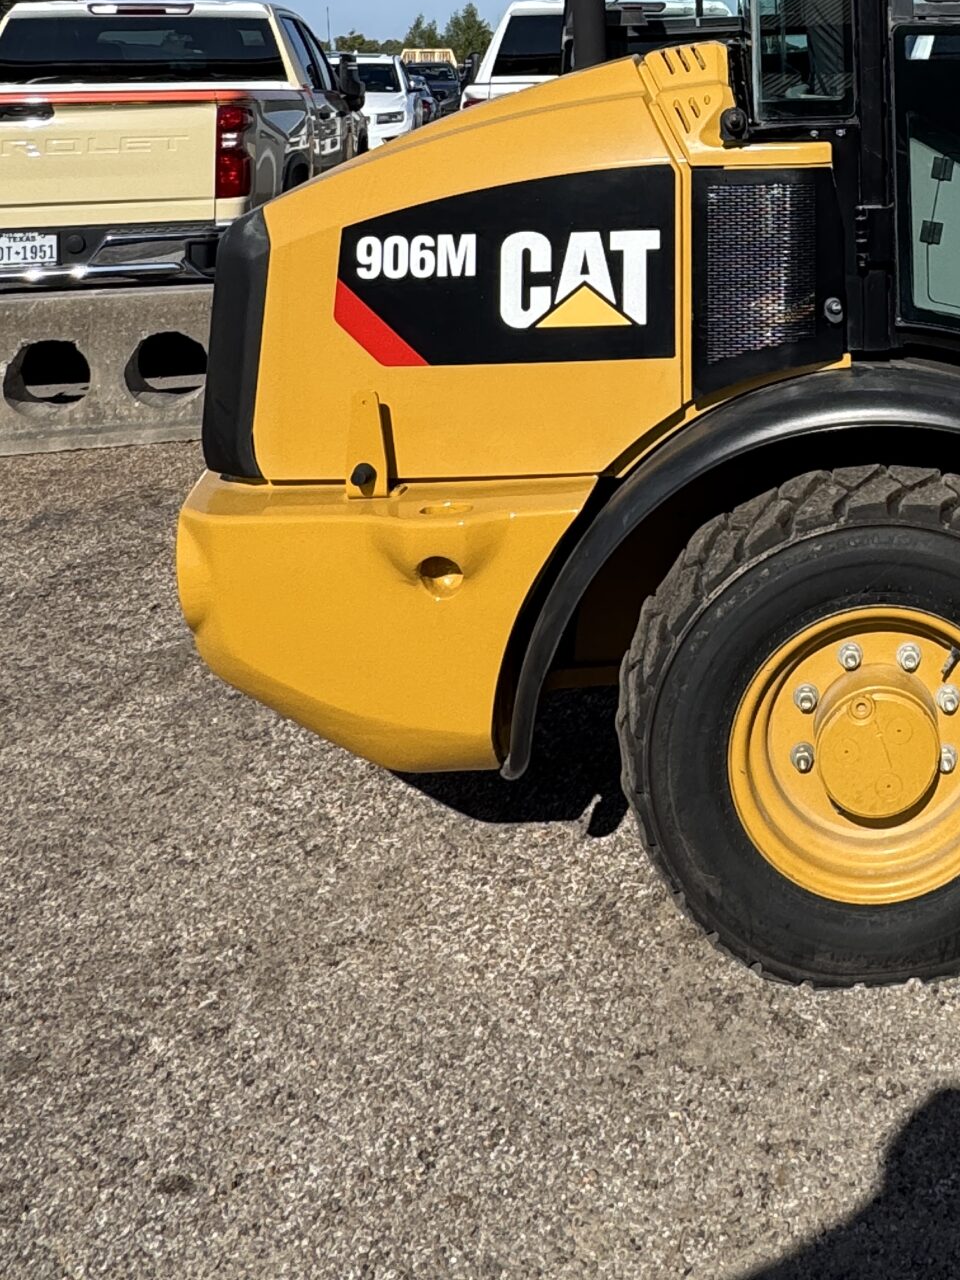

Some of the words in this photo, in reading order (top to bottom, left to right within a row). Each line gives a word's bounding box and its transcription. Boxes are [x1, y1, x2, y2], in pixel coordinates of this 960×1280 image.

[7, 235, 37, 243] TEXAS
[355, 233, 477, 280] 906M
[500, 230, 661, 329] CAT
